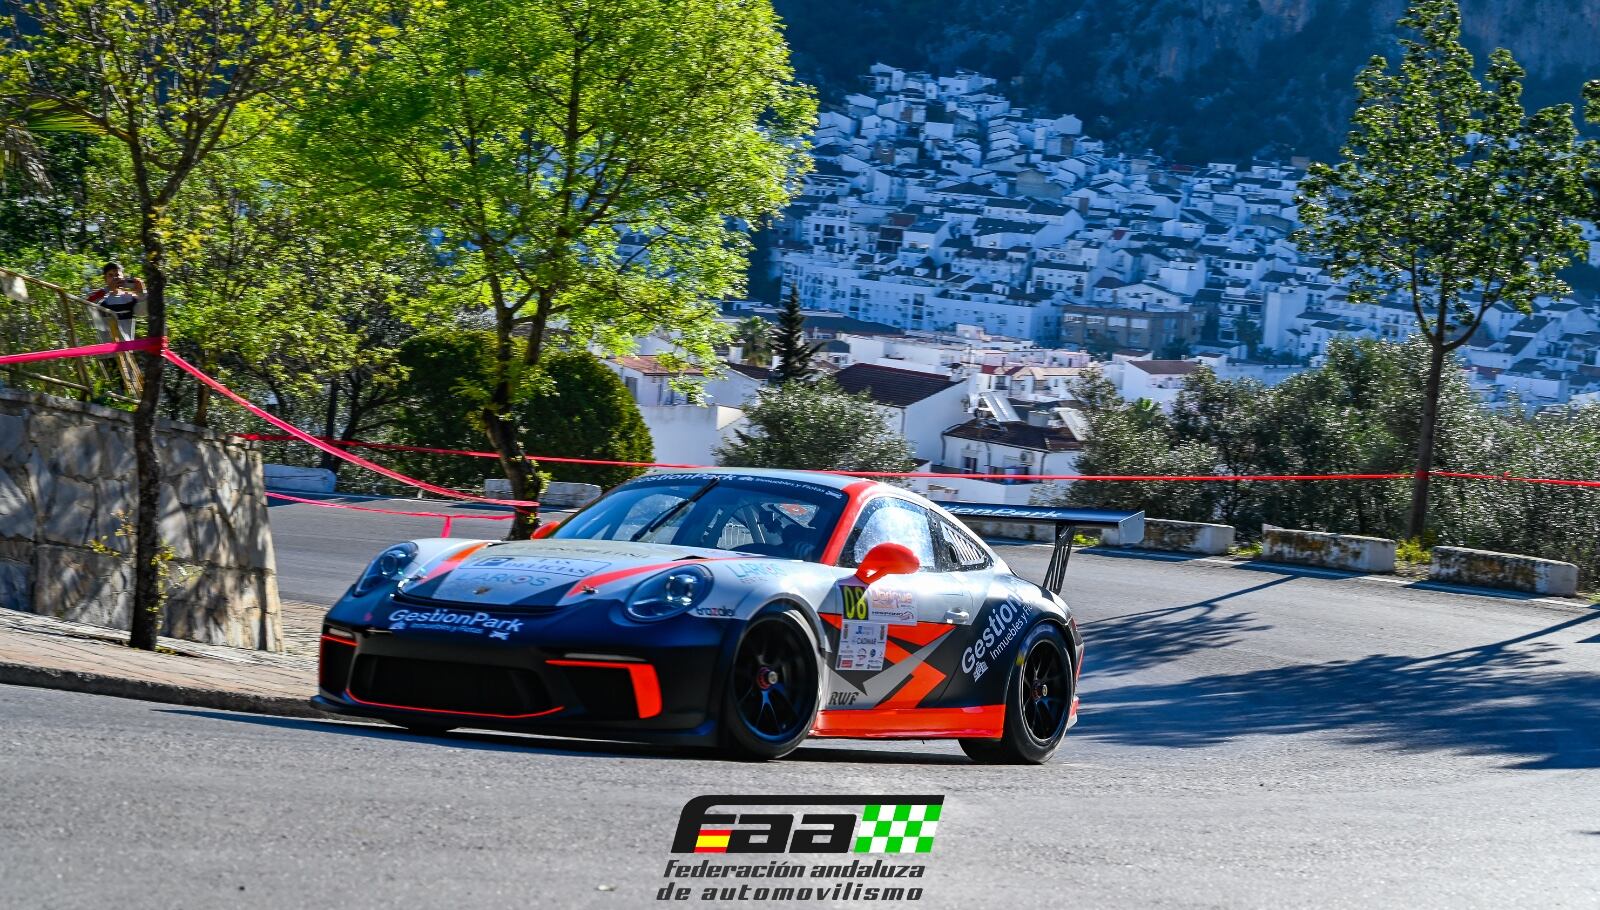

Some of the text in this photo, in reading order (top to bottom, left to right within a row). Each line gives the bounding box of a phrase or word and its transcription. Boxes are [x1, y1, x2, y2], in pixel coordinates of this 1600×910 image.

[456, 572, 551, 588] LARIOS
[843, 585, 867, 620] 08
[389, 609, 524, 632] GestionPark
[989, 619, 1024, 660] Inmuebles
[828, 691, 860, 706] RWF
